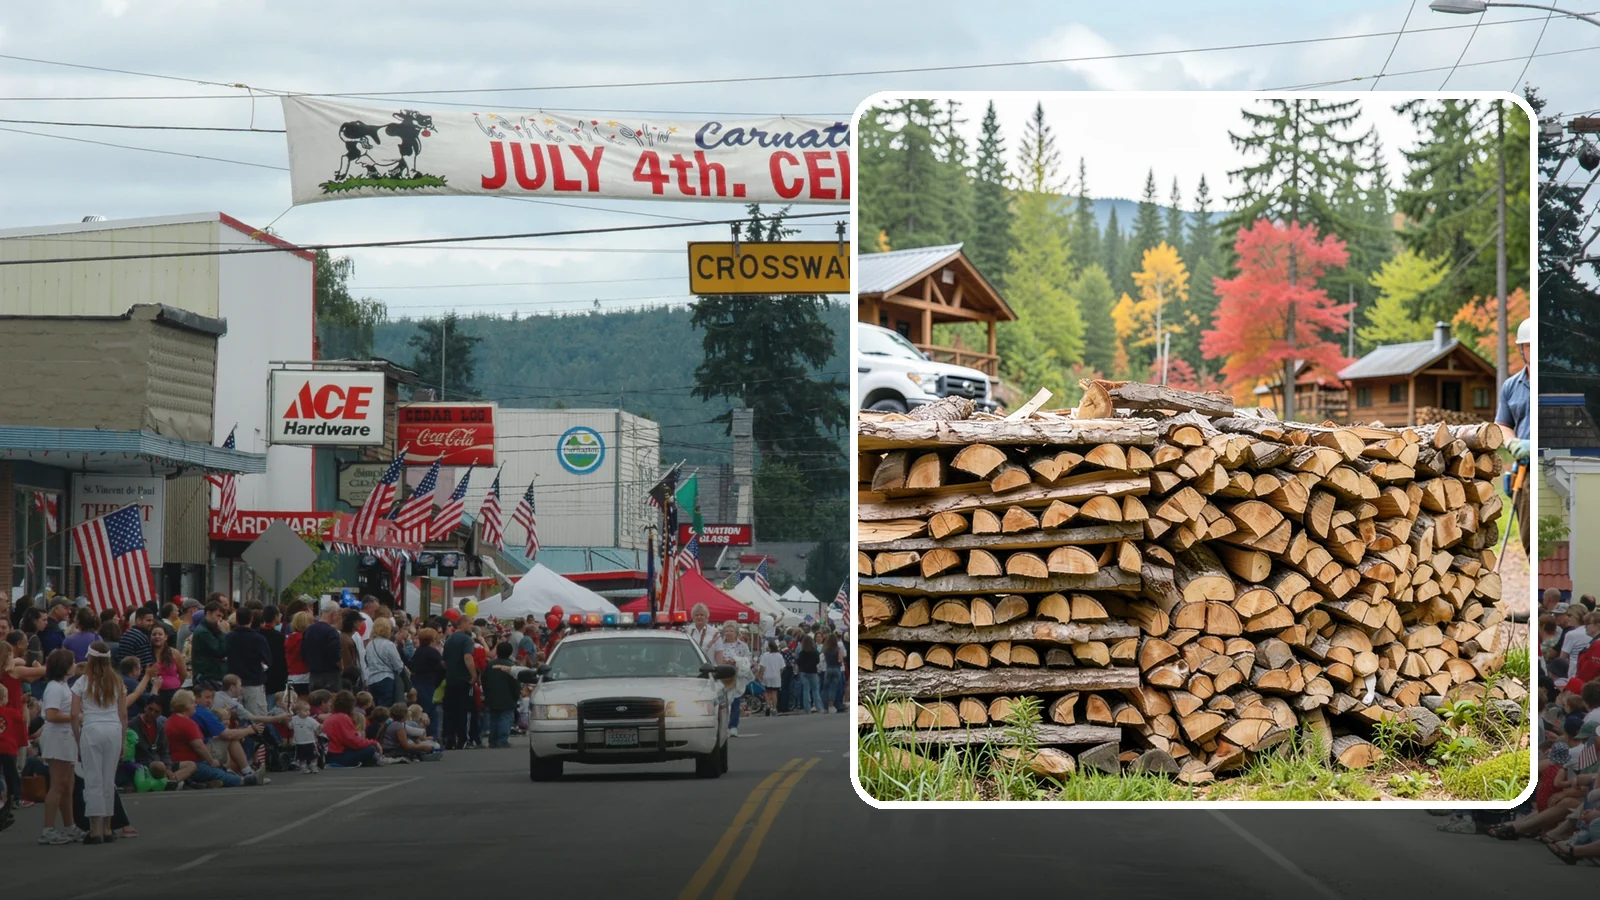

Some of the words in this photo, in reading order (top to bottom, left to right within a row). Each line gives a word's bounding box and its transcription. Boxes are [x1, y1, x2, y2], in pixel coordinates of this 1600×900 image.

[481, 140, 605, 192] JULY
[632, 150, 746, 197] 4th.
[697, 254, 850, 280] CROSSWA
[282, 380, 374, 420] ACE
[405, 409, 453, 421] CEDAR
[461, 409, 485, 421] LOG
[283, 421, 371, 437] Hardware
[416, 428, 477, 447] Coca-Cola
[95, 485, 124, 494] Vincent
[126, 486, 136, 494] de
[137, 486, 155, 495] Paul
[212, 515, 330, 536] HARDARE
[688, 526, 742, 535] CRNATION
[699, 535, 730, 543] GLASS
